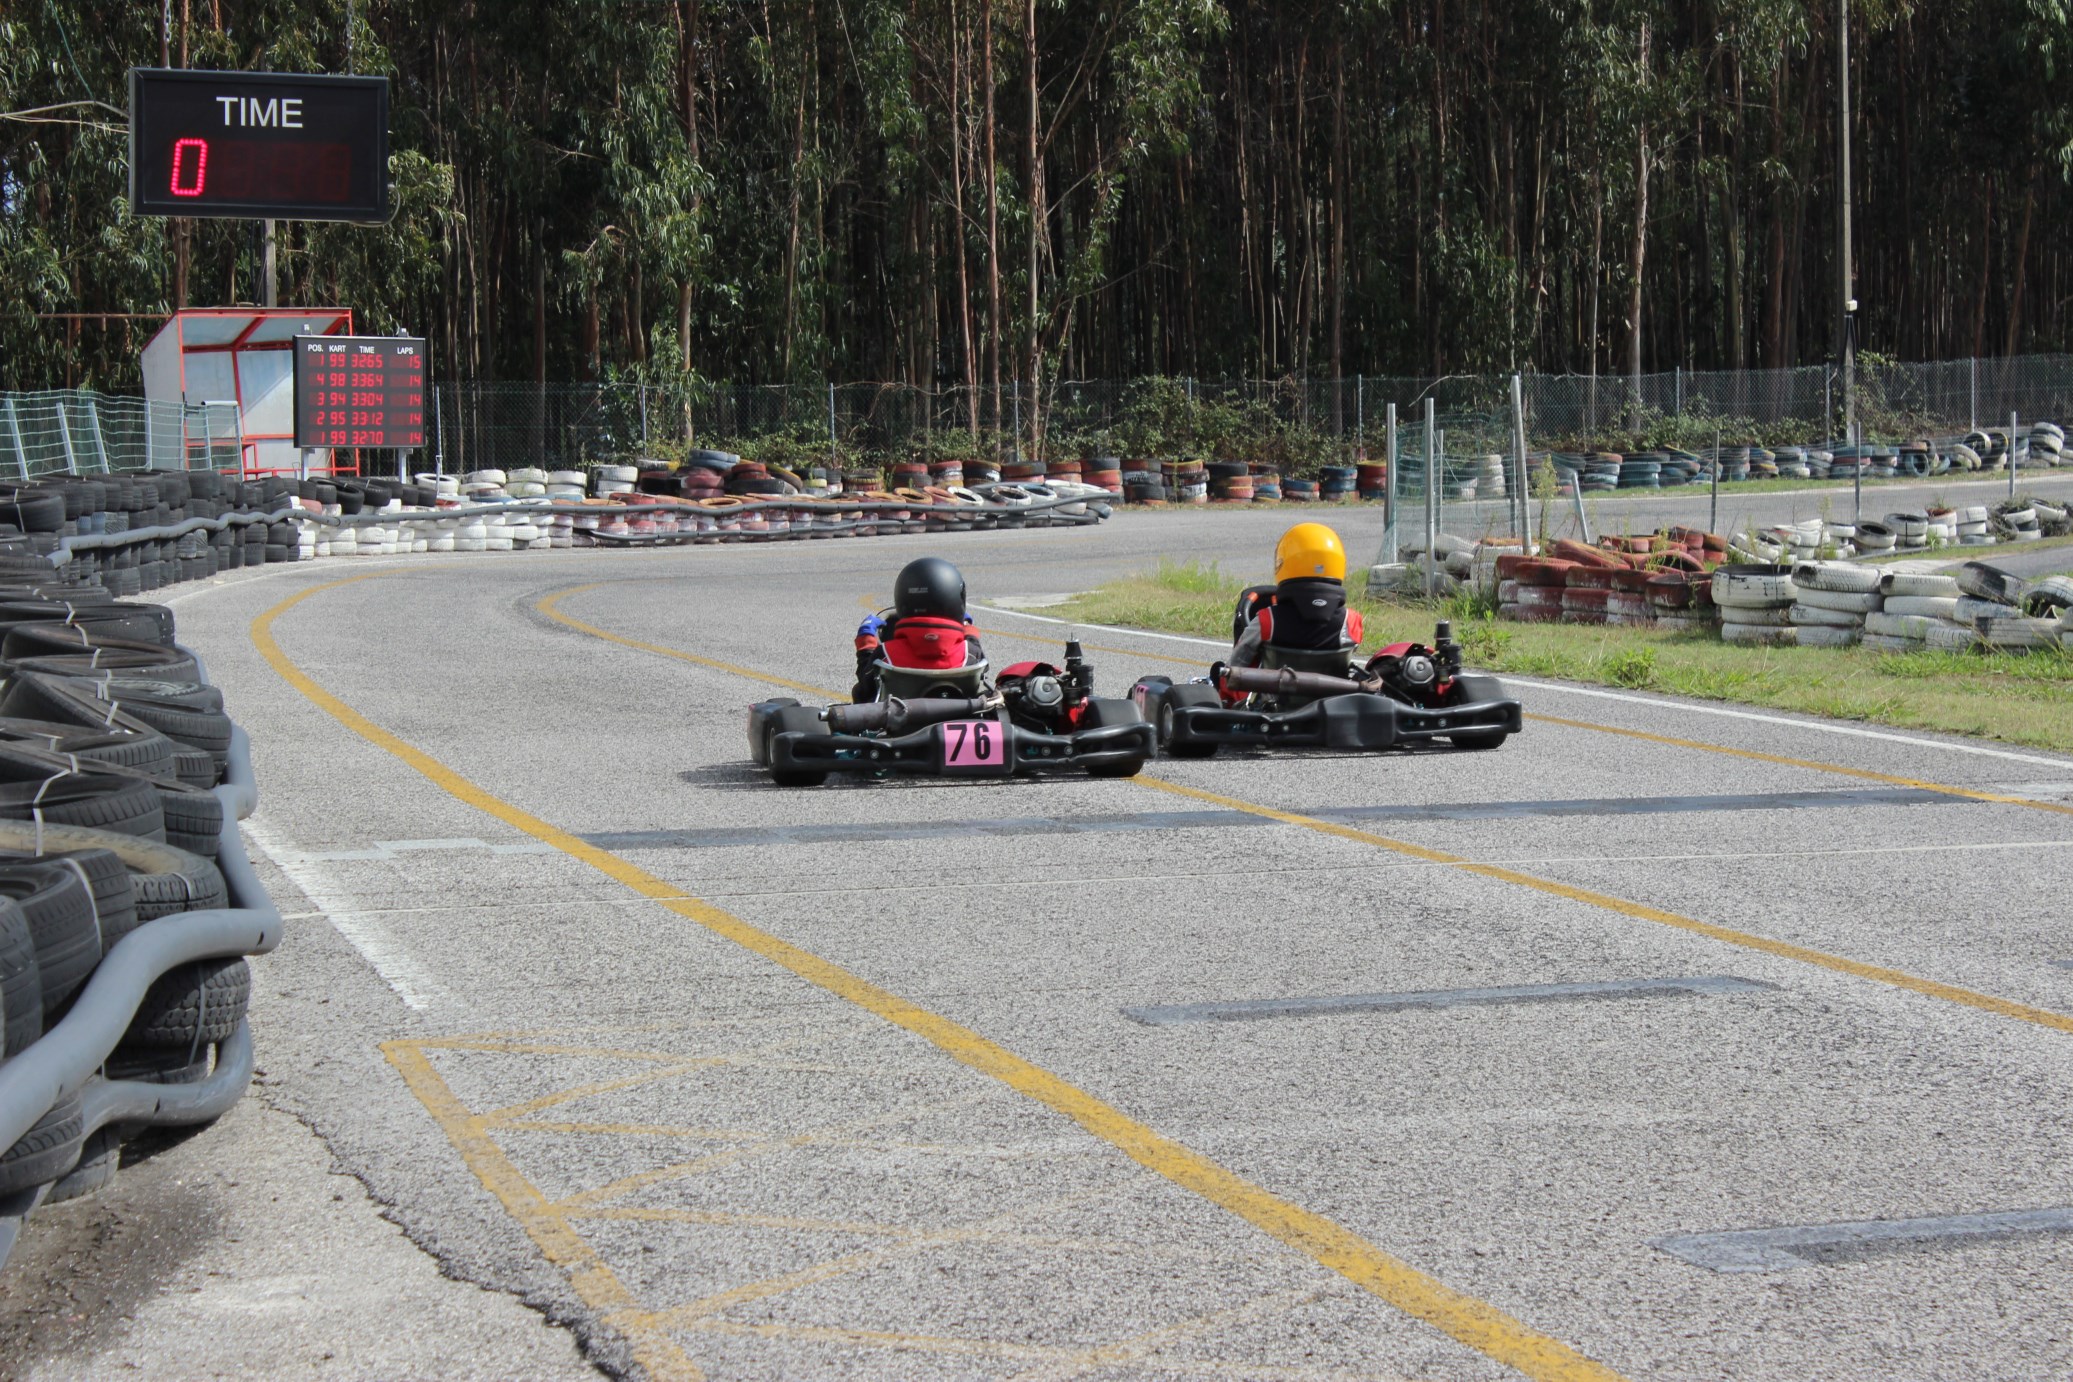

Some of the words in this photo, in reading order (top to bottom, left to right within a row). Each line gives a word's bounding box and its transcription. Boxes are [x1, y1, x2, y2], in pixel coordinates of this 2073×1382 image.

[216, 96, 303, 128] TIME
[171, 138, 207, 196] 0
[307, 344, 324, 352] POS.
[329, 345, 346, 353] KART
[359, 346, 375, 354] TIME
[397, 347, 414, 355] LAPS
[329, 353, 346, 367] 99
[409, 355, 421, 369] 15
[317, 374, 324, 386] 4
[329, 373, 346, 387] 98
[409, 375, 421, 387] 14
[317, 392, 325, 406] 3
[329, 392, 346, 406] 94
[409, 393, 421, 406] 14
[316, 411, 325, 425] 2
[330, 411, 346, 425] 95
[409, 412, 422, 425] 14
[330, 431, 347, 445] 99
[409, 432, 422, 445] 14
[946, 722, 991, 762] 76
